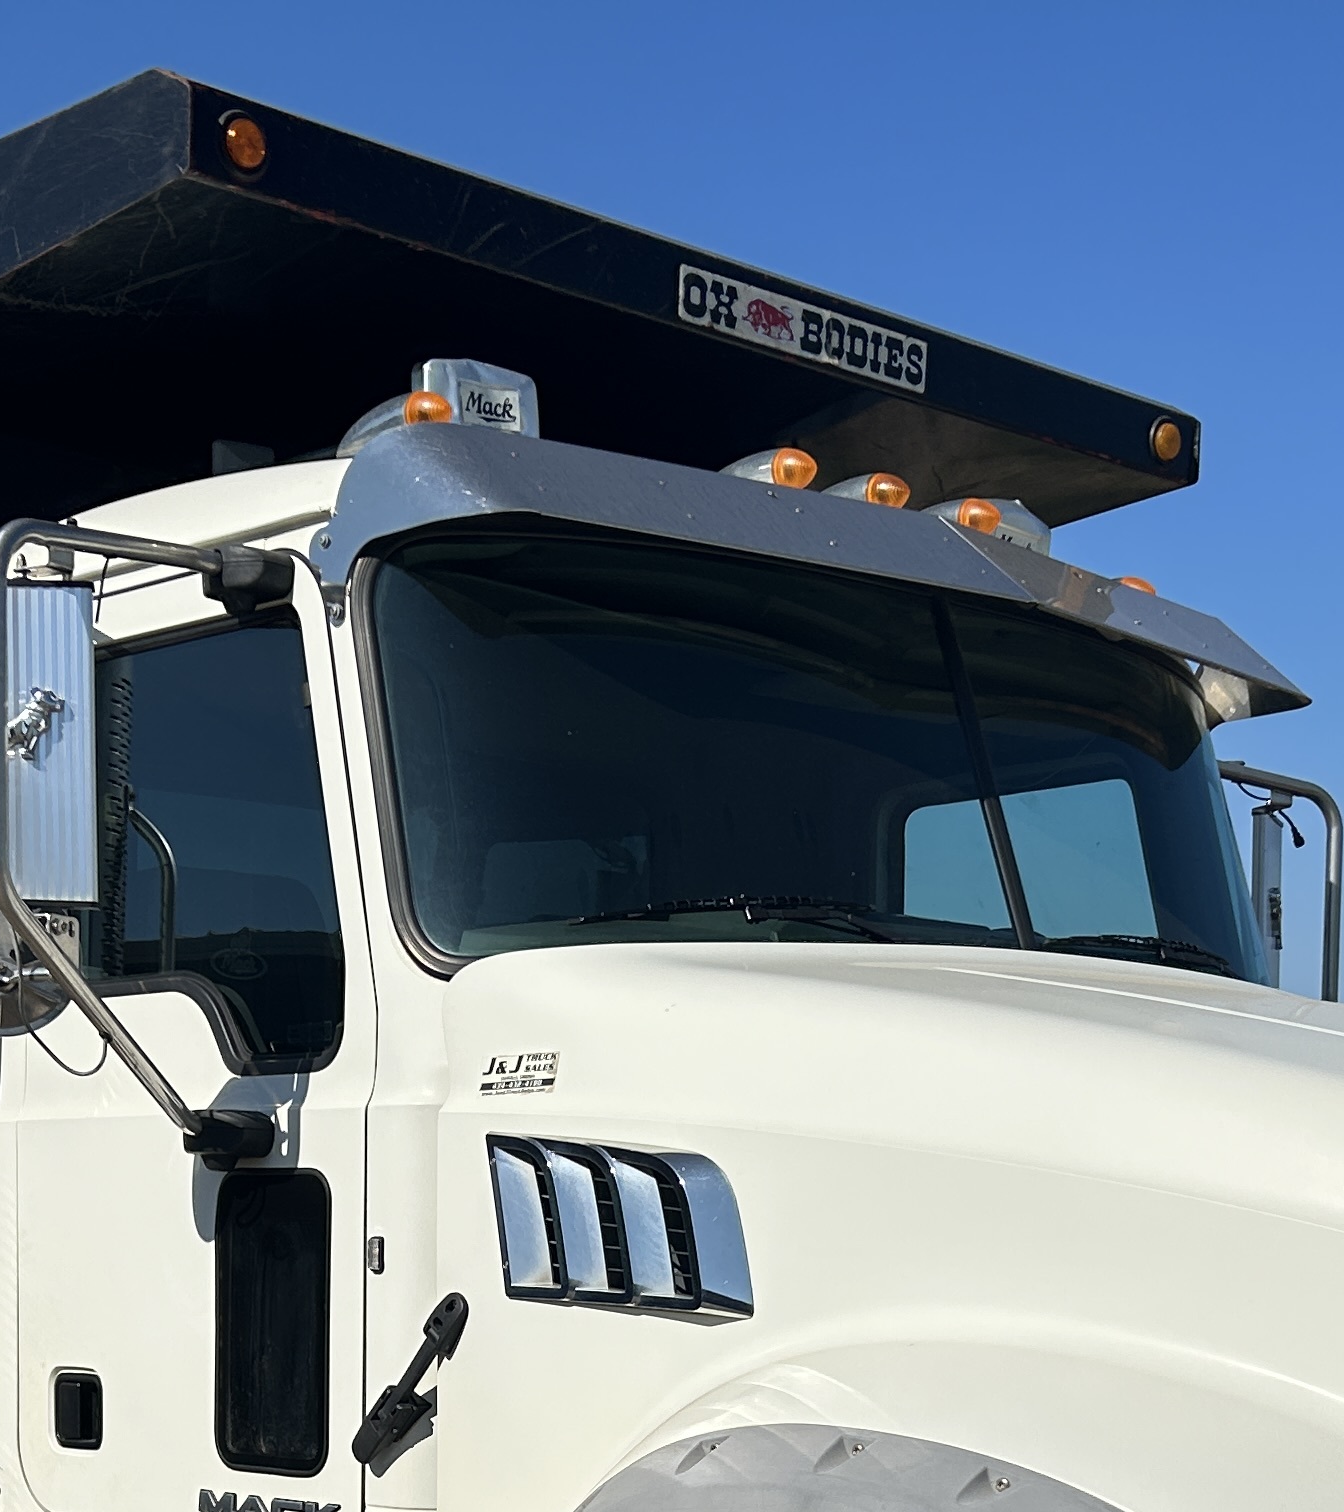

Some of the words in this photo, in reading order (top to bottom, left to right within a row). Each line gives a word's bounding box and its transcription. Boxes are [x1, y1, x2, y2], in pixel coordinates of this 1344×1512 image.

[682, 273, 738, 330] OX
[800, 308, 924, 386] BODIES
[465, 391, 516, 423] Mack
[482, 1054, 524, 1076] J&J
[525, 1052, 557, 1063] TRUCK
[524, 1063, 555, 1073] SALES
